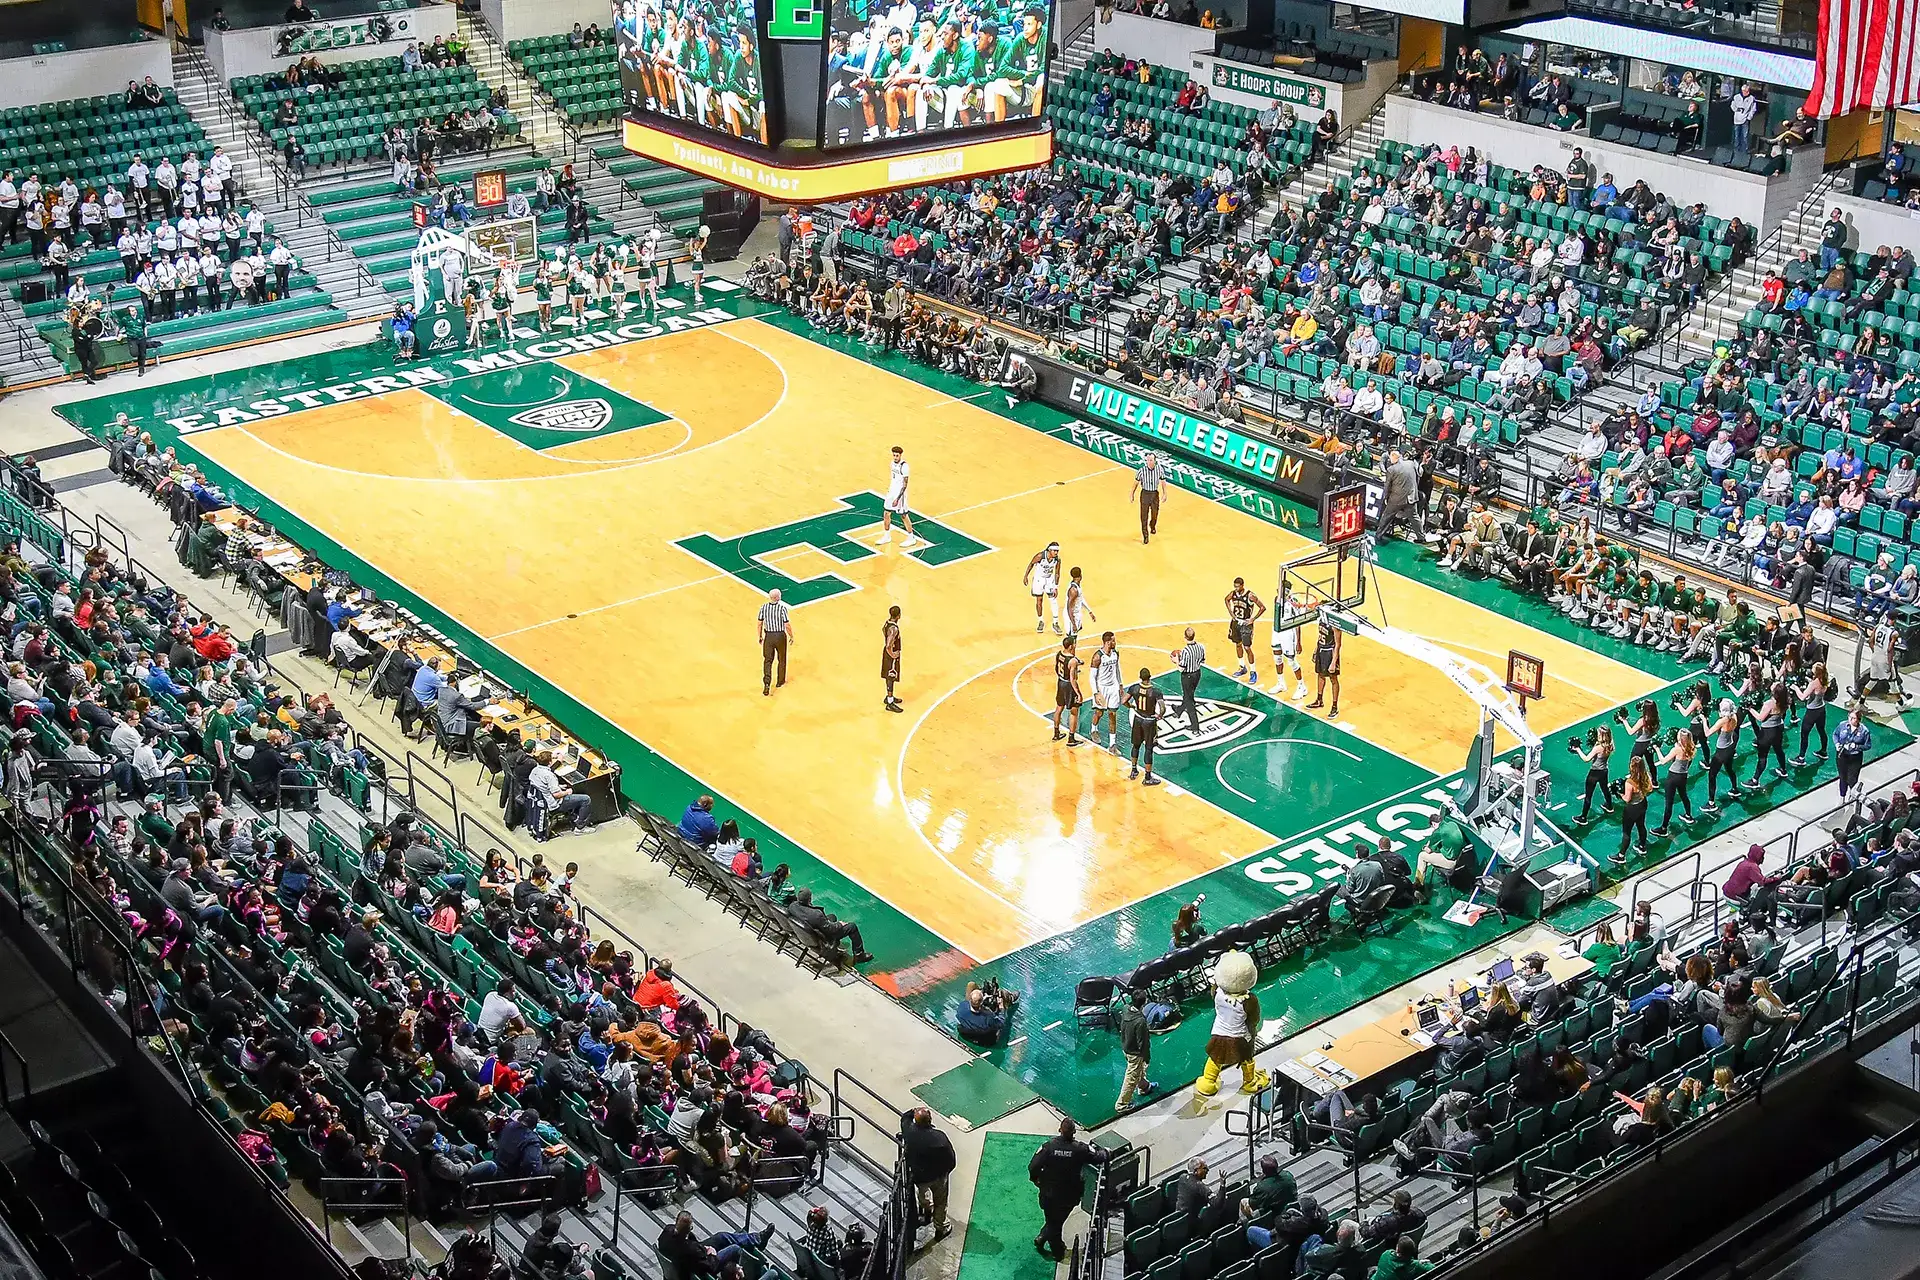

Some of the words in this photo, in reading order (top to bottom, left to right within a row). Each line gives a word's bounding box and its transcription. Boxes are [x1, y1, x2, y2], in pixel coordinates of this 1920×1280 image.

[1231, 71, 1239, 87] E
[1240, 74, 1271, 93] HOOPS
[1273, 80, 1305, 101] GROUP
[731, 161, 753, 180] Ann
[757, 170, 800, 191] Arbor
[434, 299, 448, 315] E
[165, 366, 447, 434] EASTERN
[452, 307, 737, 374] MICHIGAN
[532, 402, 606, 427] MAC
[1069, 377, 1304, 483] EMUEAGLES.COM
[1333, 508, 1357, 537] 30
[1235, 608, 1246, 620] 23
[1876, 630, 1887, 646] 21
[1138, 695, 1147, 711] 11
[1054, 1149, 1073, 1157] POLICE
